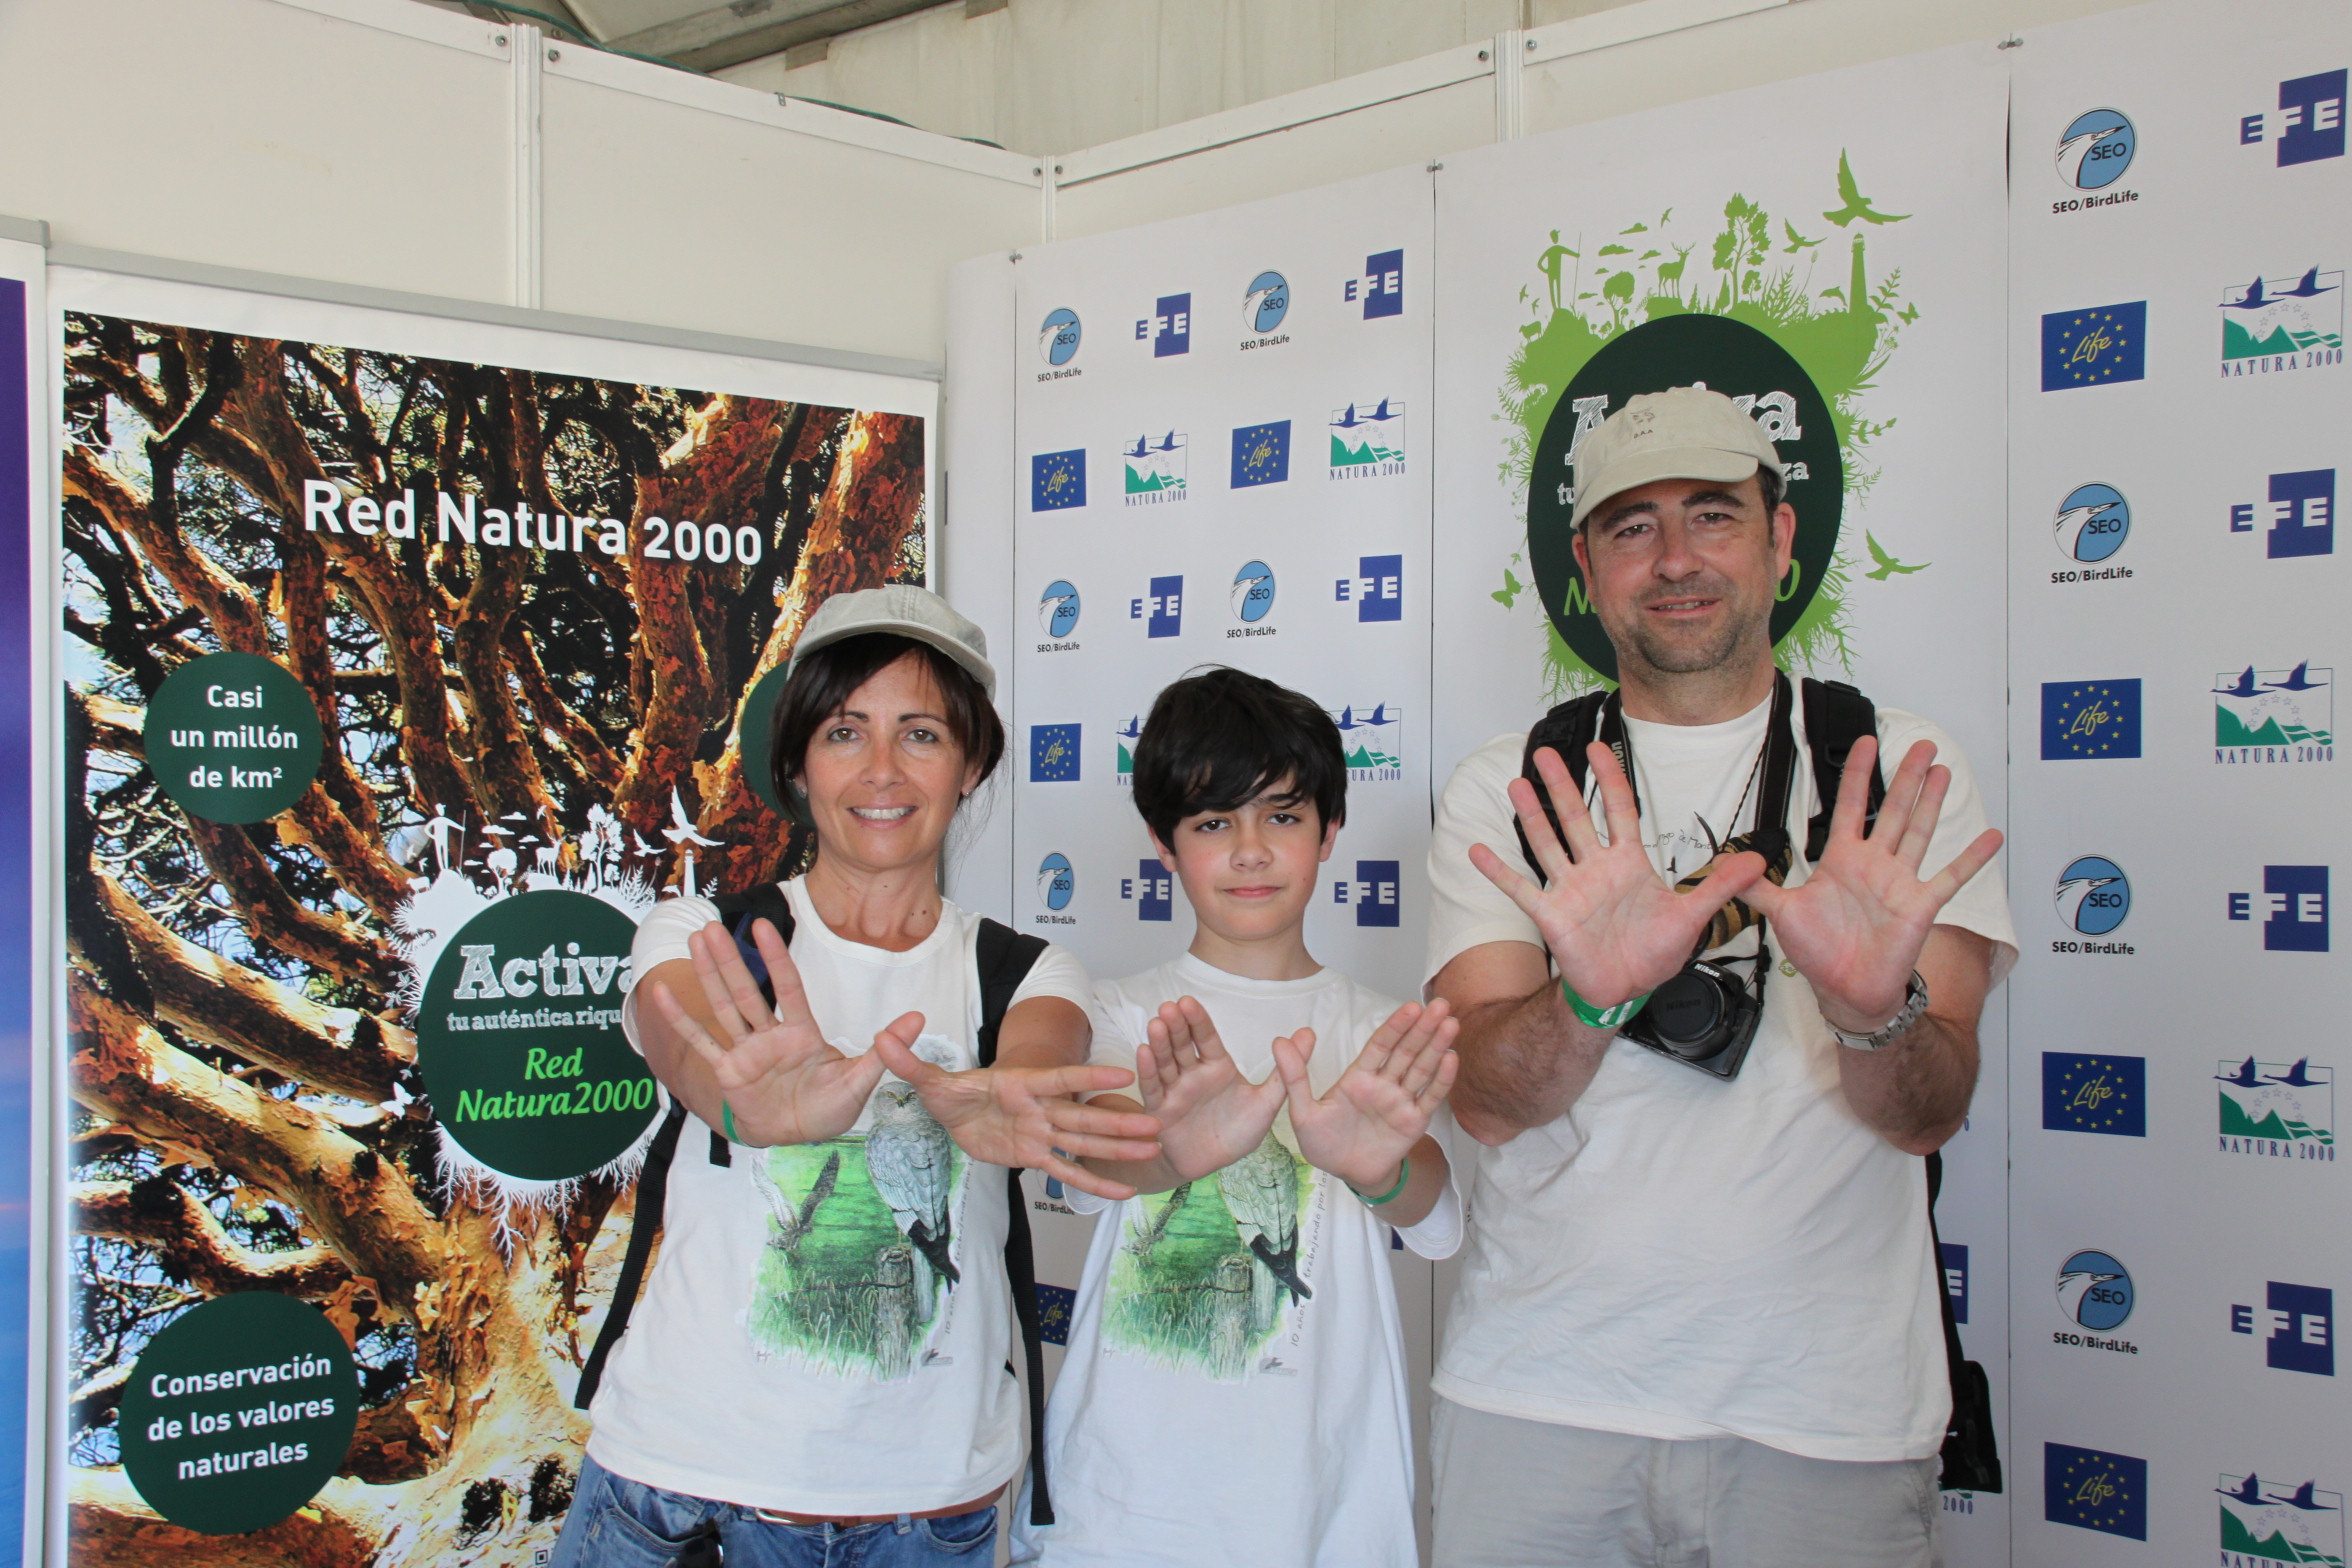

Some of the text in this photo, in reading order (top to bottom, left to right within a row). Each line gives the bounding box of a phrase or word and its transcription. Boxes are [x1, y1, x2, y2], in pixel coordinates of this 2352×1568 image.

[2240, 98, 2340, 146] EFE
[2091, 142, 2127, 161] SEO
[2052, 190, 2139, 214] SEO/BirdLife
[1344, 271, 1399, 302] EFE
[1263, 297, 1284, 311] SEO
[1135, 313, 1188, 341] EFE
[1056, 332, 1077, 346] SEO
[1240, 334, 1290, 351] SEO/BirdLife
[2071, 327, 2112, 363] Life
[1037, 368, 1082, 382] SEO/BirdLife
[2221, 349, 2342, 378] NATURA 2000
[1248, 444, 1272, 468] Life
[1047, 470, 1069, 493] Life
[1329, 462, 1406, 481] NATURA 2000
[1124, 490, 1187, 507] NATURA 2000
[304, 479, 762, 566] Red Natura 2000
[2230, 496, 2329, 533] EFE
[2088, 519, 2121, 534] SEO
[2051, 567, 2133, 583] SEO/BirdLife
[1249, 588, 1270, 600] SEO
[1335, 576, 1398, 602] EFE
[1057, 606, 1076, 618] SEO
[1130, 595, 1179, 620] EFE
[1226, 626, 1276, 639] SEO/BirdLife
[1037, 641, 1080, 654] SEO/BirdLife
[207, 685, 263, 709] Casi
[2070, 701, 2109, 736] Life
[170, 724, 299, 749] un millón
[1045, 741, 1065, 764] Life
[2215, 746, 2333, 765] NATURA 2000
[189, 765, 223, 788] de
[1352, 768, 1400, 781] URA 2000
[1054, 880, 1070, 891] SEO
[1121, 879, 1169, 901] EFE
[1334, 882, 1395, 905] EFE
[2089, 893, 2122, 907] SEO
[2228, 893, 2322, 922] EFE
[1036, 915, 1076, 925] SEO/BirdLife
[2052, 941, 2135, 955] SEO/BirdLife
[1694, 963, 1720, 978] Nikon
[447, 1005, 622, 1031] tu auténtica riqu
[524, 1047, 584, 1080] Red
[2073, 1075, 2113, 1110] Life
[2219, 1136, 2334, 1162] NATURA 2000
[1290, 1333, 1300, 1347] 10
[1296, 1303, 1306, 1329] años
[1303, 1214, 1321, 1279] trabajando
[1317, 1191, 1326, 1211] por
[2091, 1288, 2126, 1306] SEO
[1044, 1302, 1064, 1327] Life
[2231, 1304, 2327, 1346] EFE
[2053, 1332, 2138, 1355] SEO/BirdLife
[150, 1353, 332, 1398] Conservación
[147, 1398, 335, 1441] de los valores
[178, 1442, 309, 1480] naturales
[2076, 1473, 2115, 1506] Life
[1943, 1495, 1973, 1515] 2000
